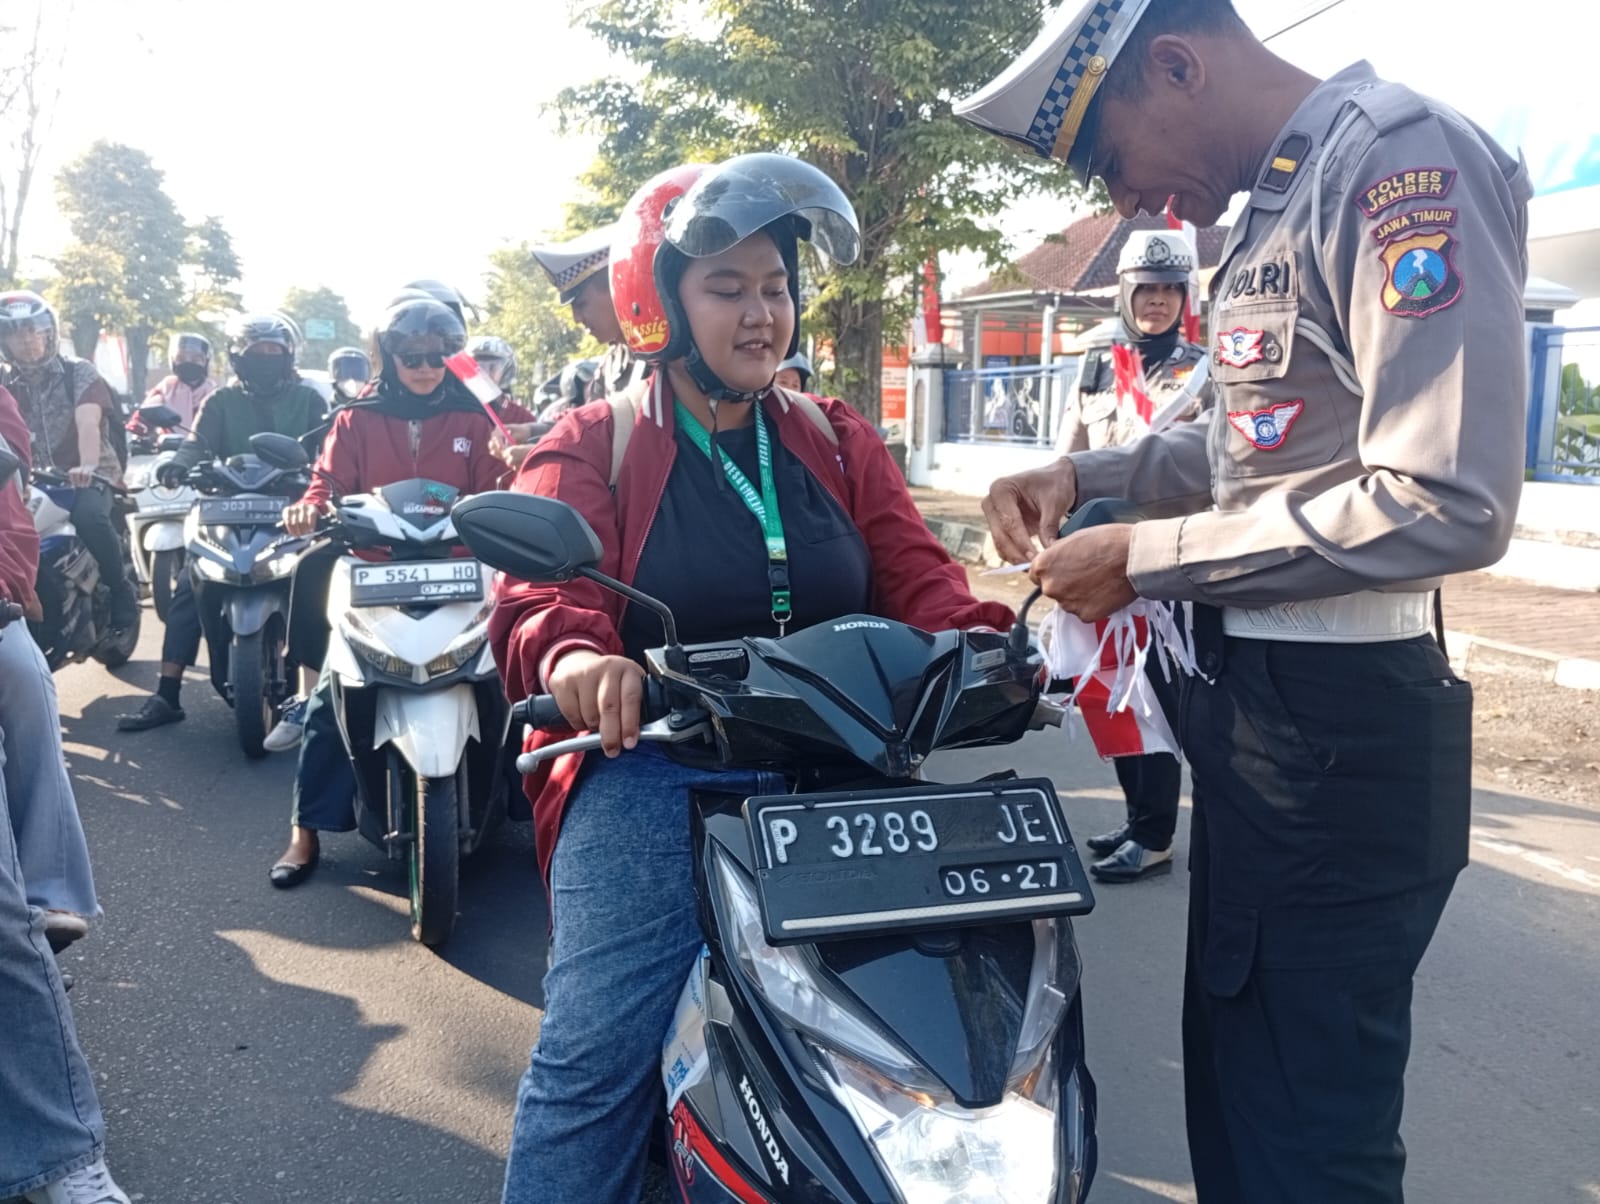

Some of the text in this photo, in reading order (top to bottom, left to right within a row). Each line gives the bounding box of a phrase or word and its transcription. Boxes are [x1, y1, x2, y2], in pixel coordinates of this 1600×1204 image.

[1367, 171, 1442, 202] POLRES
[1369, 183, 1442, 212] JEMBER
[1377, 210, 1452, 239] JAWA TIMUR
[358, 570, 369, 584] P
[385, 567, 430, 582] 5541
[832, 621, 890, 632] HONDA
[770, 804, 1047, 864] P 3289 JE
[739, 1074, 790, 1186] HONDA
